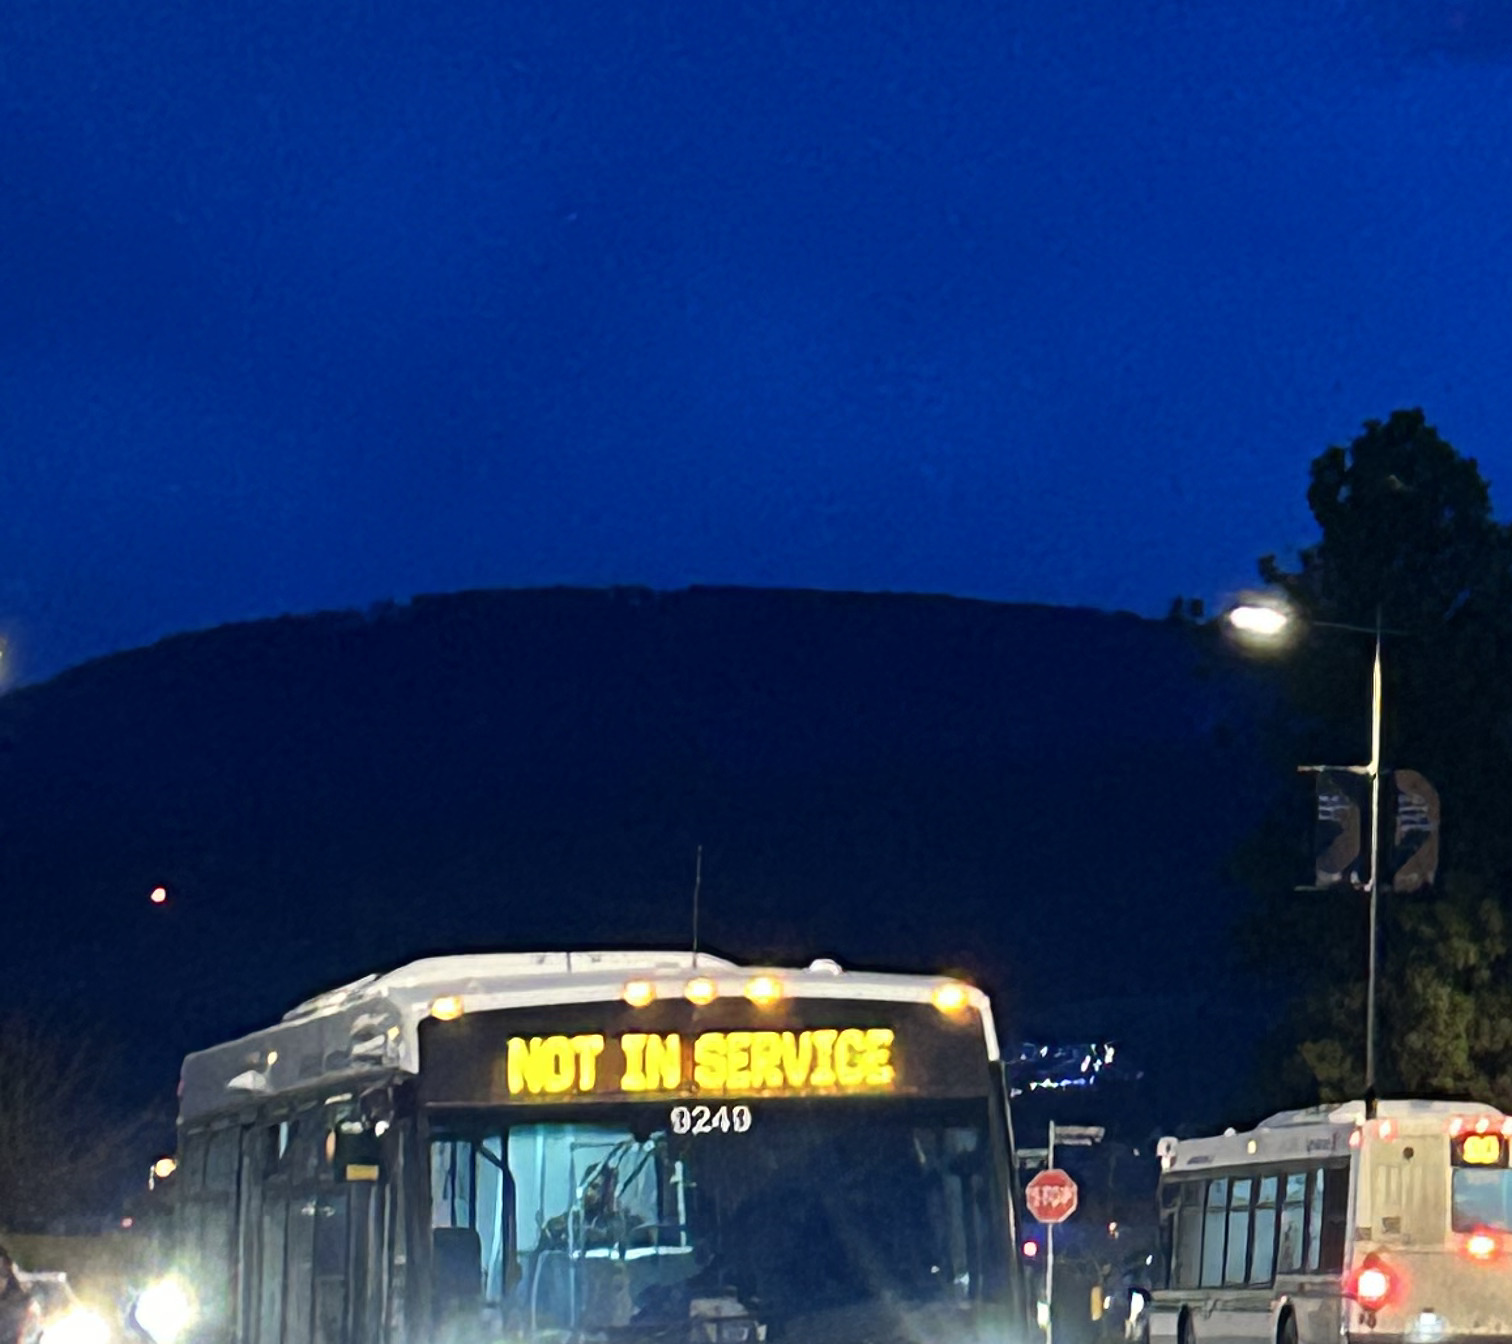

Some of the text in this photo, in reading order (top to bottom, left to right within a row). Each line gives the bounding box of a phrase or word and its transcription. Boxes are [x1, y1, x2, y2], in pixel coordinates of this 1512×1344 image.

[507, 1028, 894, 1095] NOT IN SERVICE
